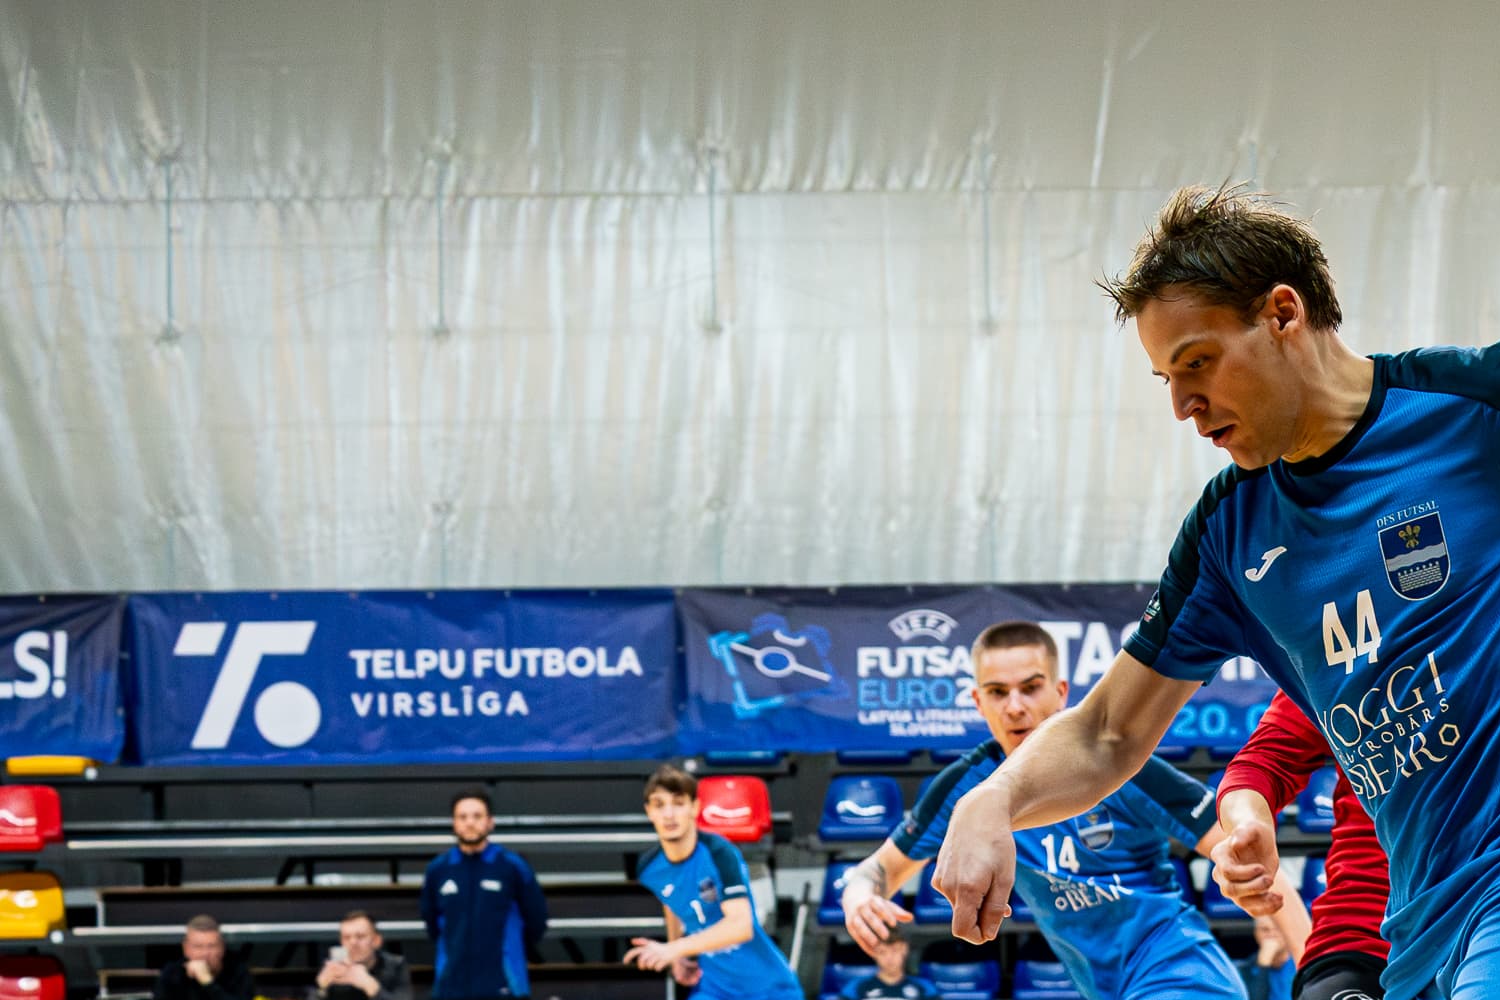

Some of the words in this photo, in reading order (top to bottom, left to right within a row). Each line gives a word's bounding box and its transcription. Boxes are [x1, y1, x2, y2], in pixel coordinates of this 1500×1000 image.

[1376, 513, 1396, 528] DFS
[1397, 500, 1439, 521] FUTSAL
[1322, 589, 1383, 675] 44
[0, 630, 68, 699] S!
[349, 649, 465, 679] TELPU
[473, 646, 643, 679] FUTBOLA
[857, 645, 974, 678] FUTSA
[351, 685, 529, 717] VIRSLĪGA
[857, 677, 979, 709] EURO2
[1316, 651, 1446, 751] YOGGI
[1041, 834, 1080, 874] 14
